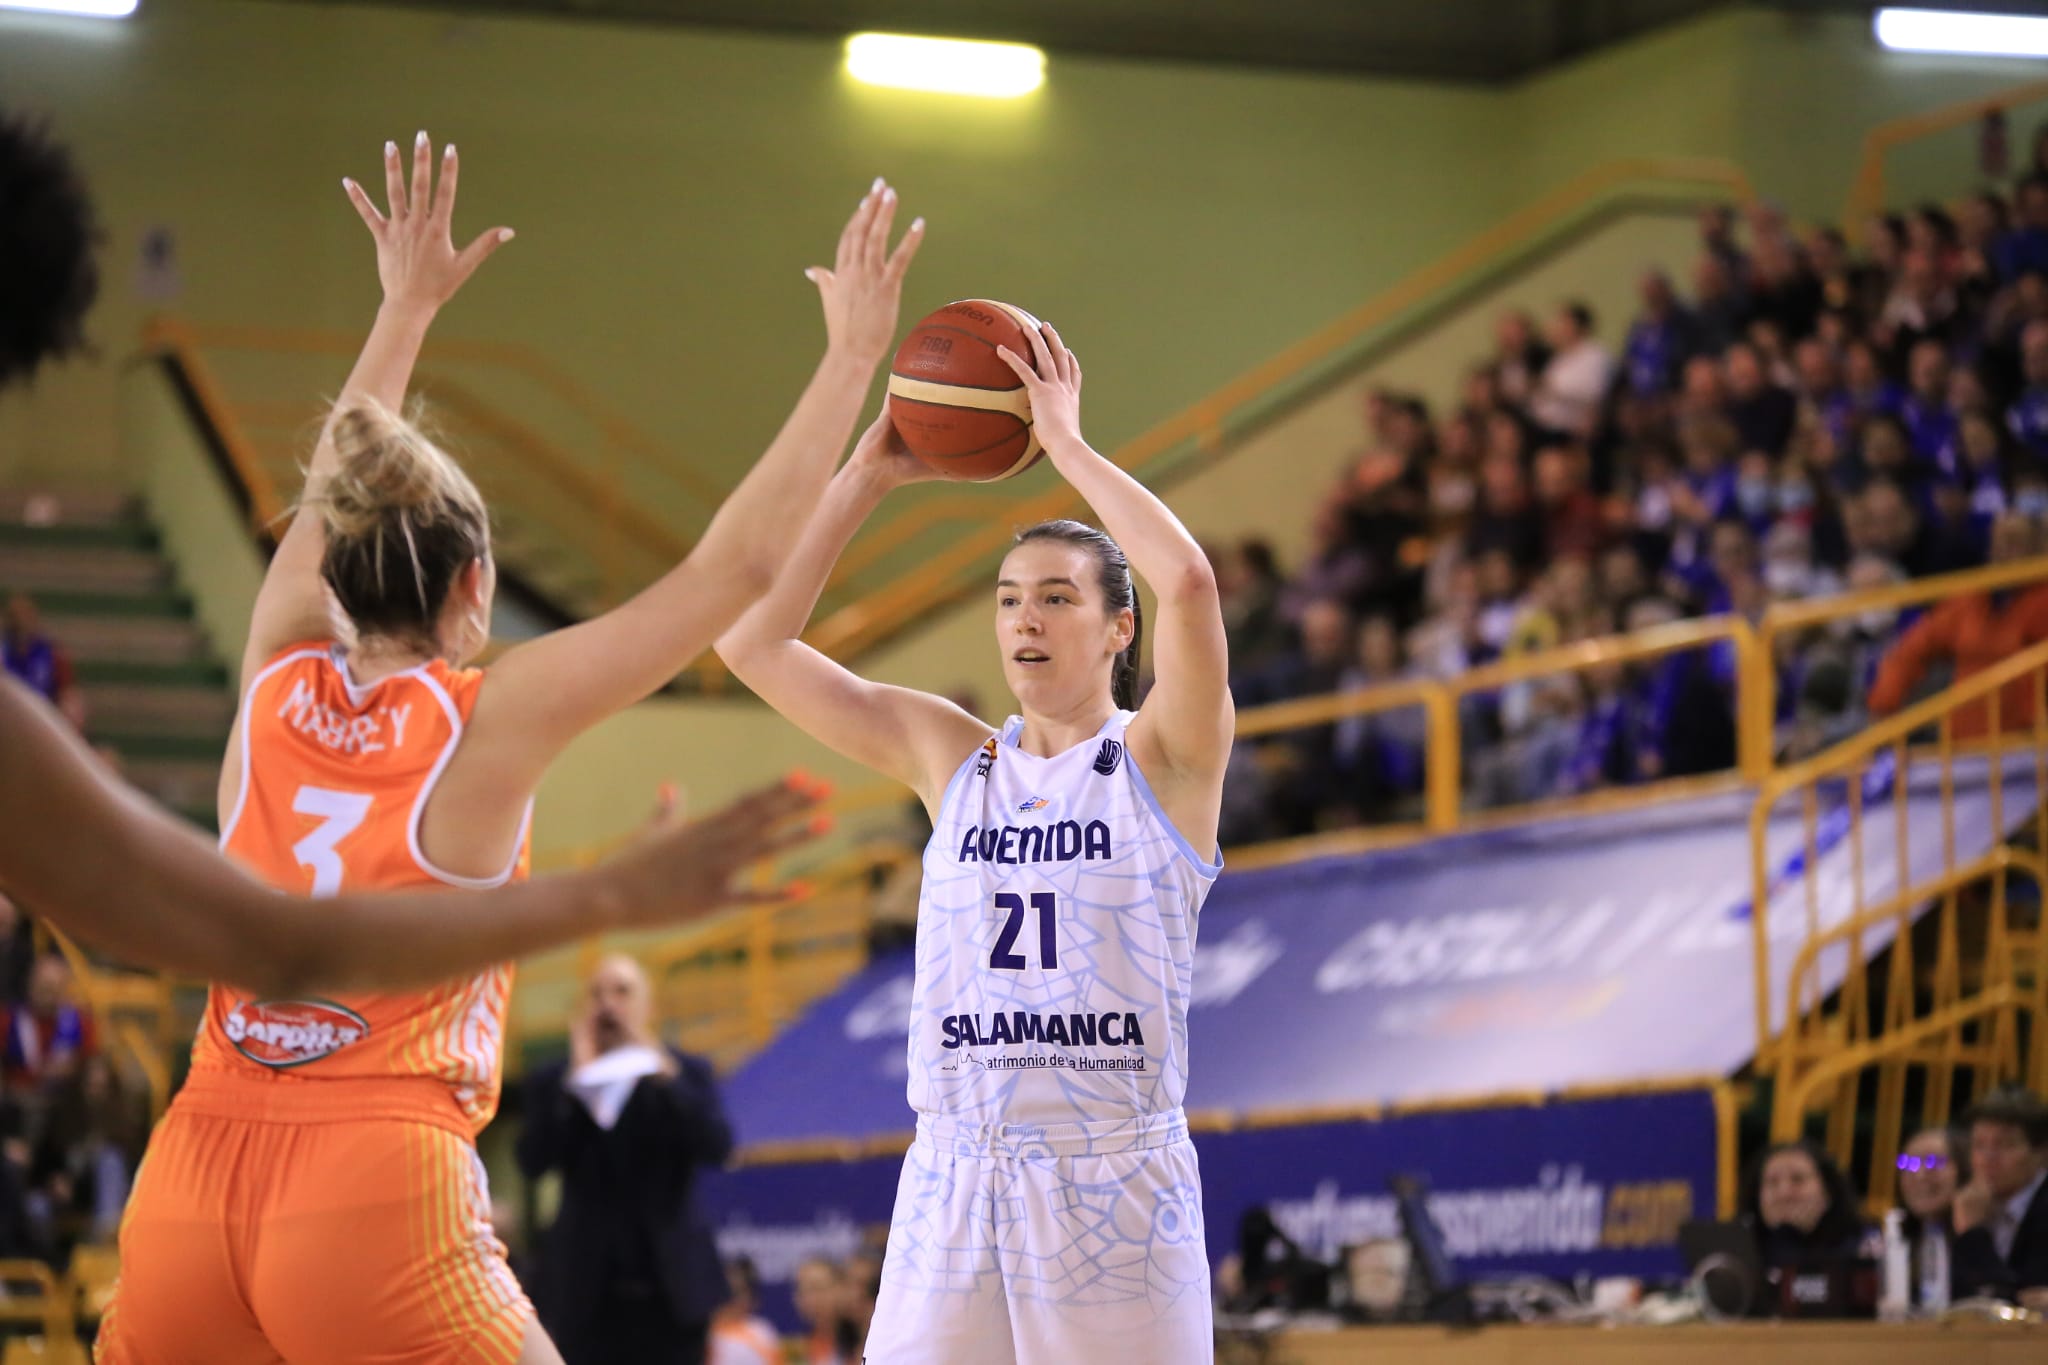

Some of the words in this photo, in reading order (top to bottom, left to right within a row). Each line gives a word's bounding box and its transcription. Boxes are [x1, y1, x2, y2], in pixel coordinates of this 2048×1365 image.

[922, 336, 953, 354] FIBA
[291, 785, 374, 898] 3
[958, 819, 1112, 864] AVENIDA
[989, 892, 1059, 970] 21
[941, 1011, 1145, 1049] SALAMANCA
[985, 1053, 1046, 1069] atrimonio
[1050, 1053, 1064, 1066] de
[1079, 1055, 1144, 1069] Humanidad
